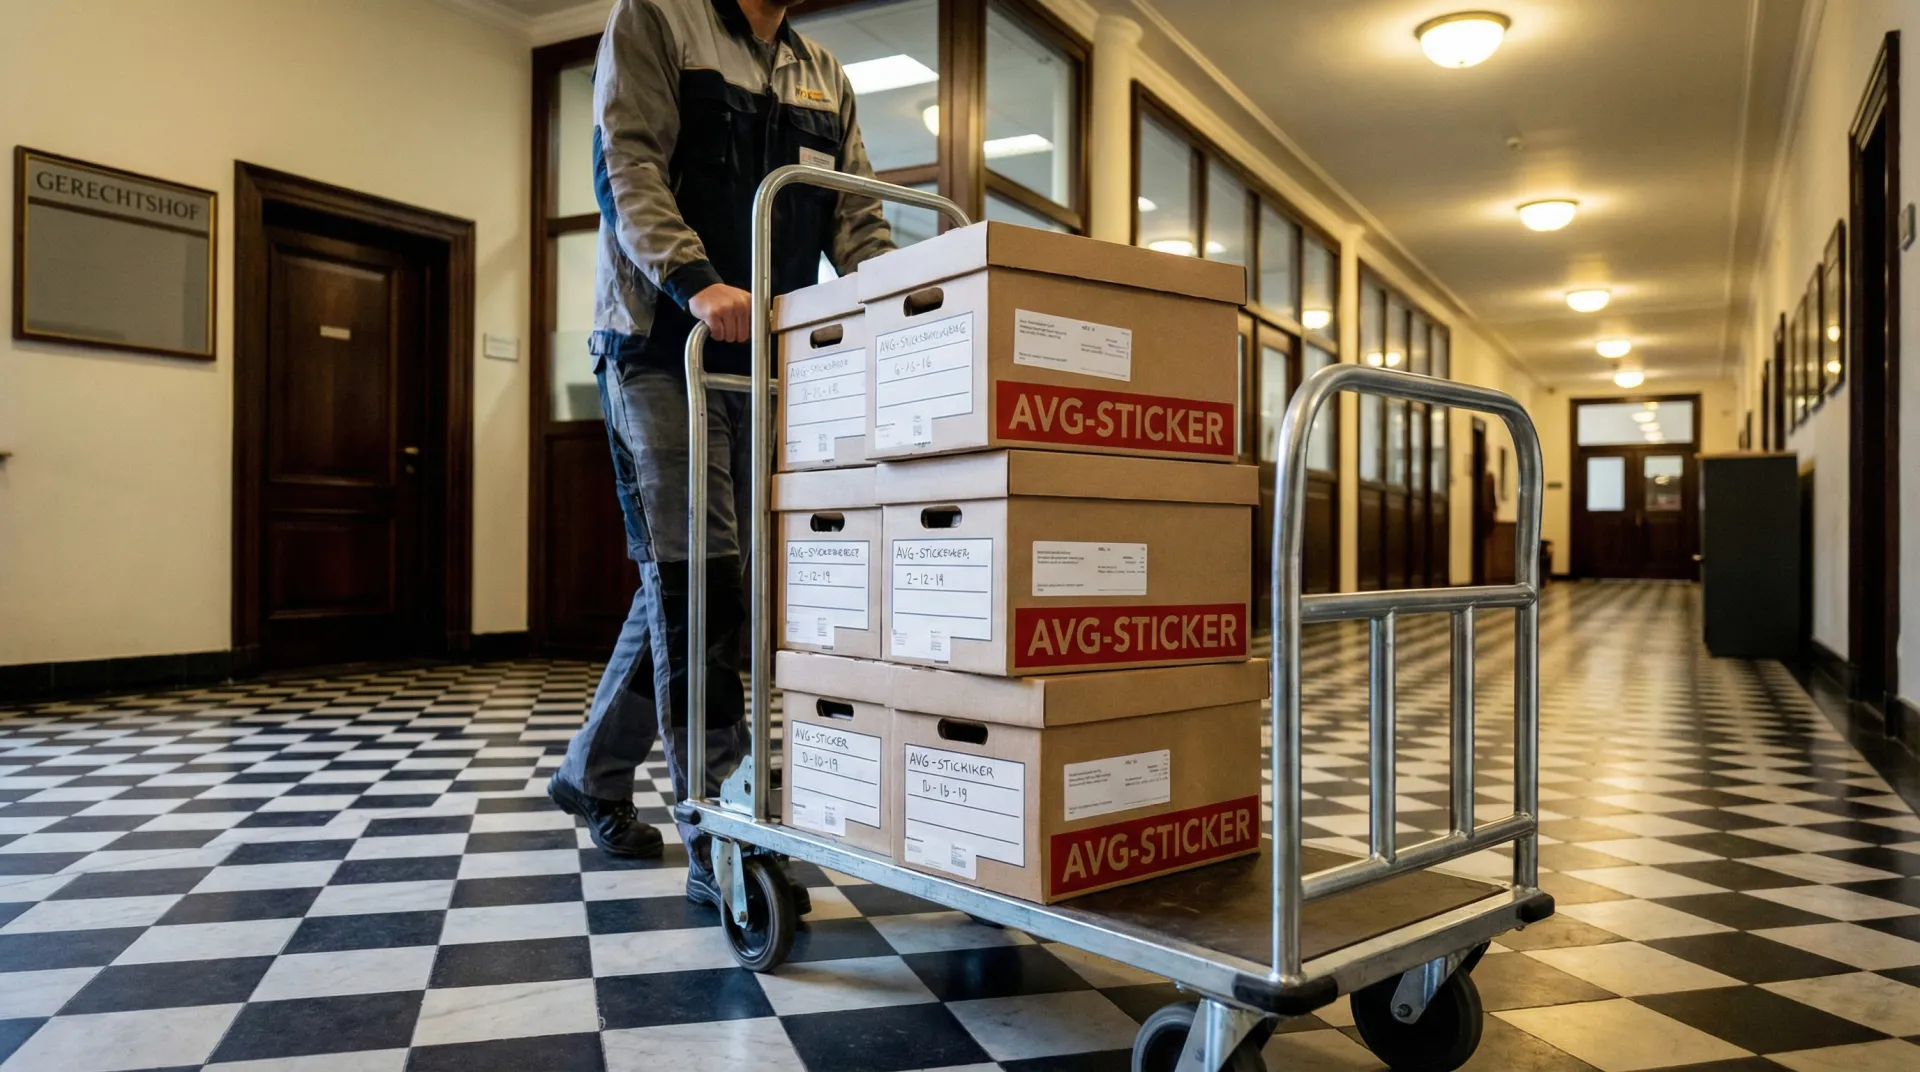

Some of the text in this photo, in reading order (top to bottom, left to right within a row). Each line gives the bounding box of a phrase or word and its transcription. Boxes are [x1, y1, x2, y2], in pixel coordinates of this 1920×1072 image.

[36, 171, 201, 221] GERECHTSHOF
[1008, 393, 1223, 446] AVG-STICKER
[906, 572, 944, 587] 2-12-19
[1027, 613, 1237, 656] AVG-STICKER
[795, 728, 849, 749] AVG-STICKER
[909, 752, 995, 779] AVG-STICKIKER
[1062, 808, 1251, 883] AVG-STICKER
